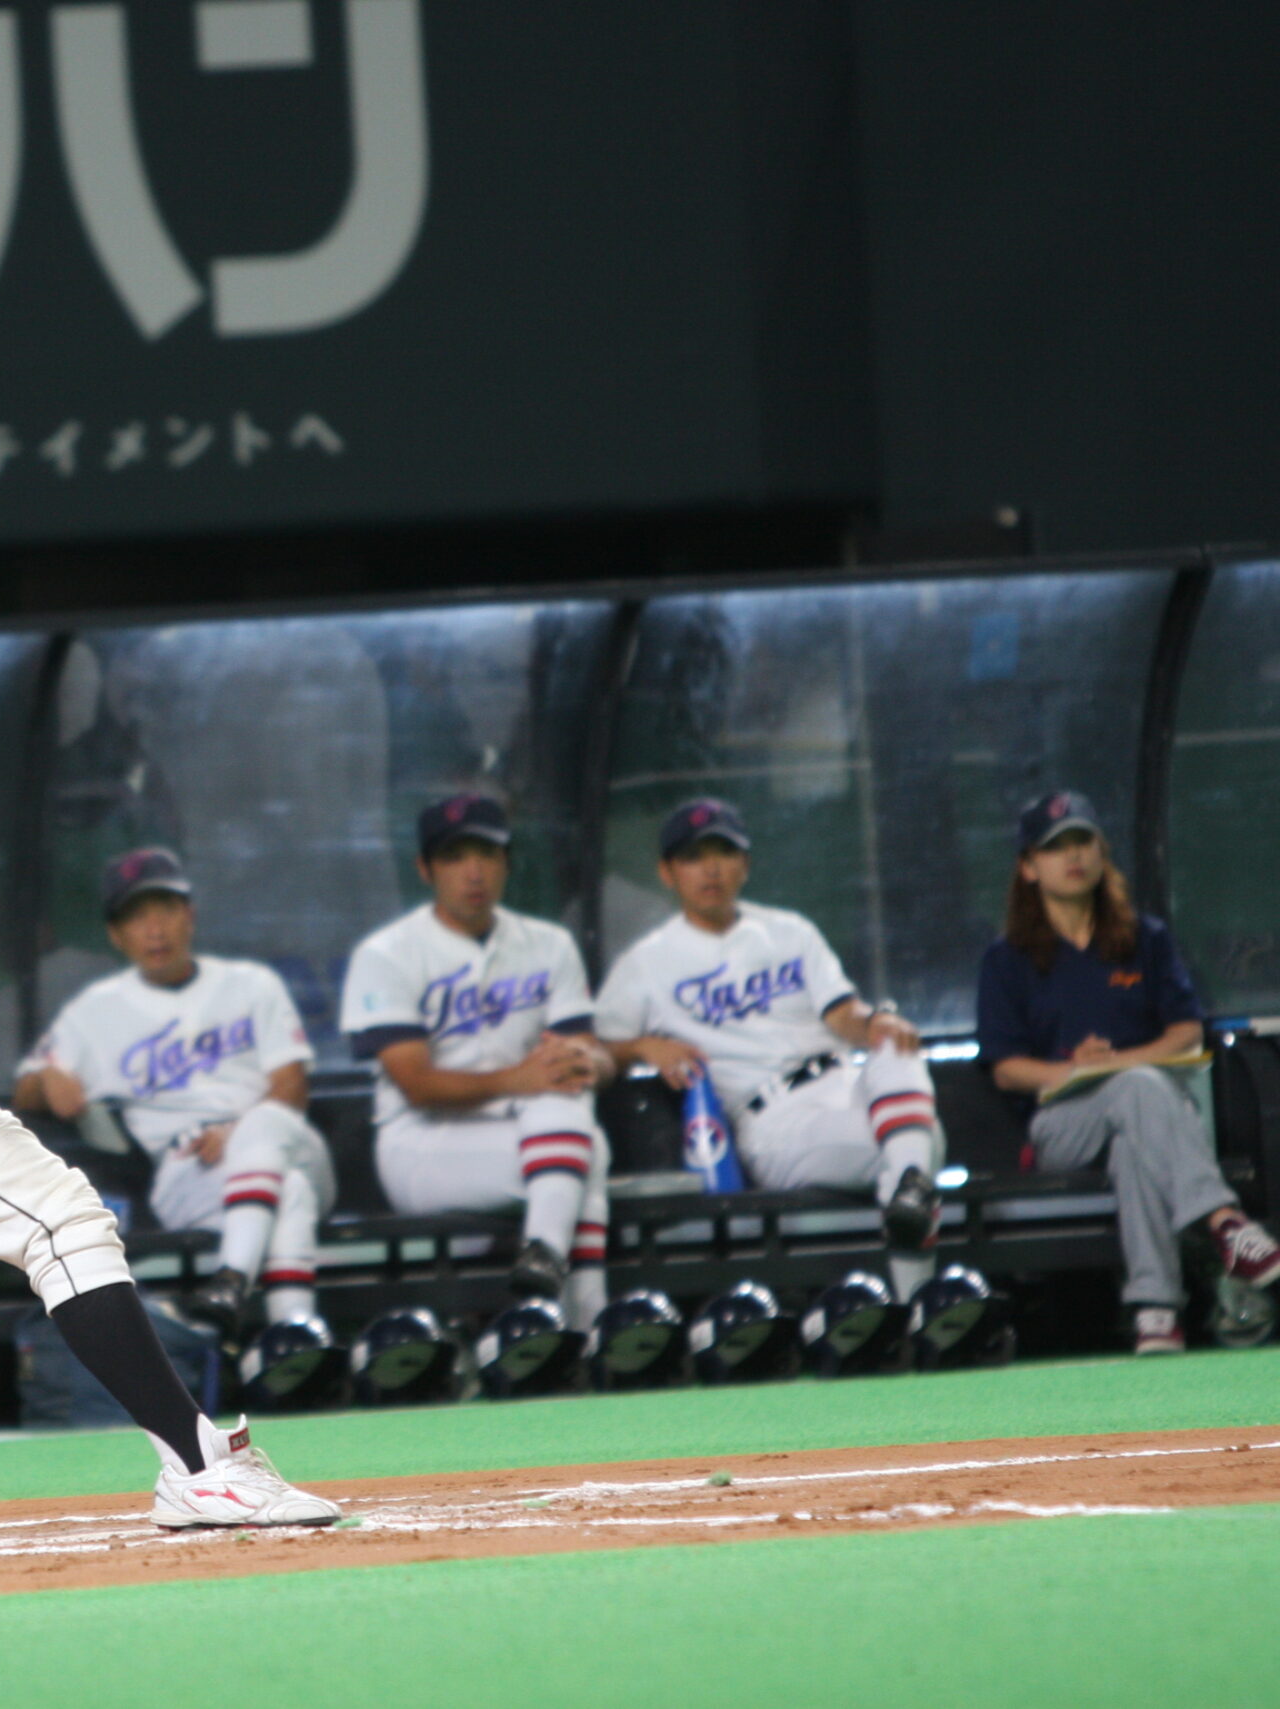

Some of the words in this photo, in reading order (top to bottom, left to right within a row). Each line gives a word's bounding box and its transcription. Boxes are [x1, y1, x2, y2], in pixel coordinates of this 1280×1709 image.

[418, 960, 550, 1042] Taga
[674, 950, 805, 1027] Taga
[119, 1016, 256, 1097] Taga
